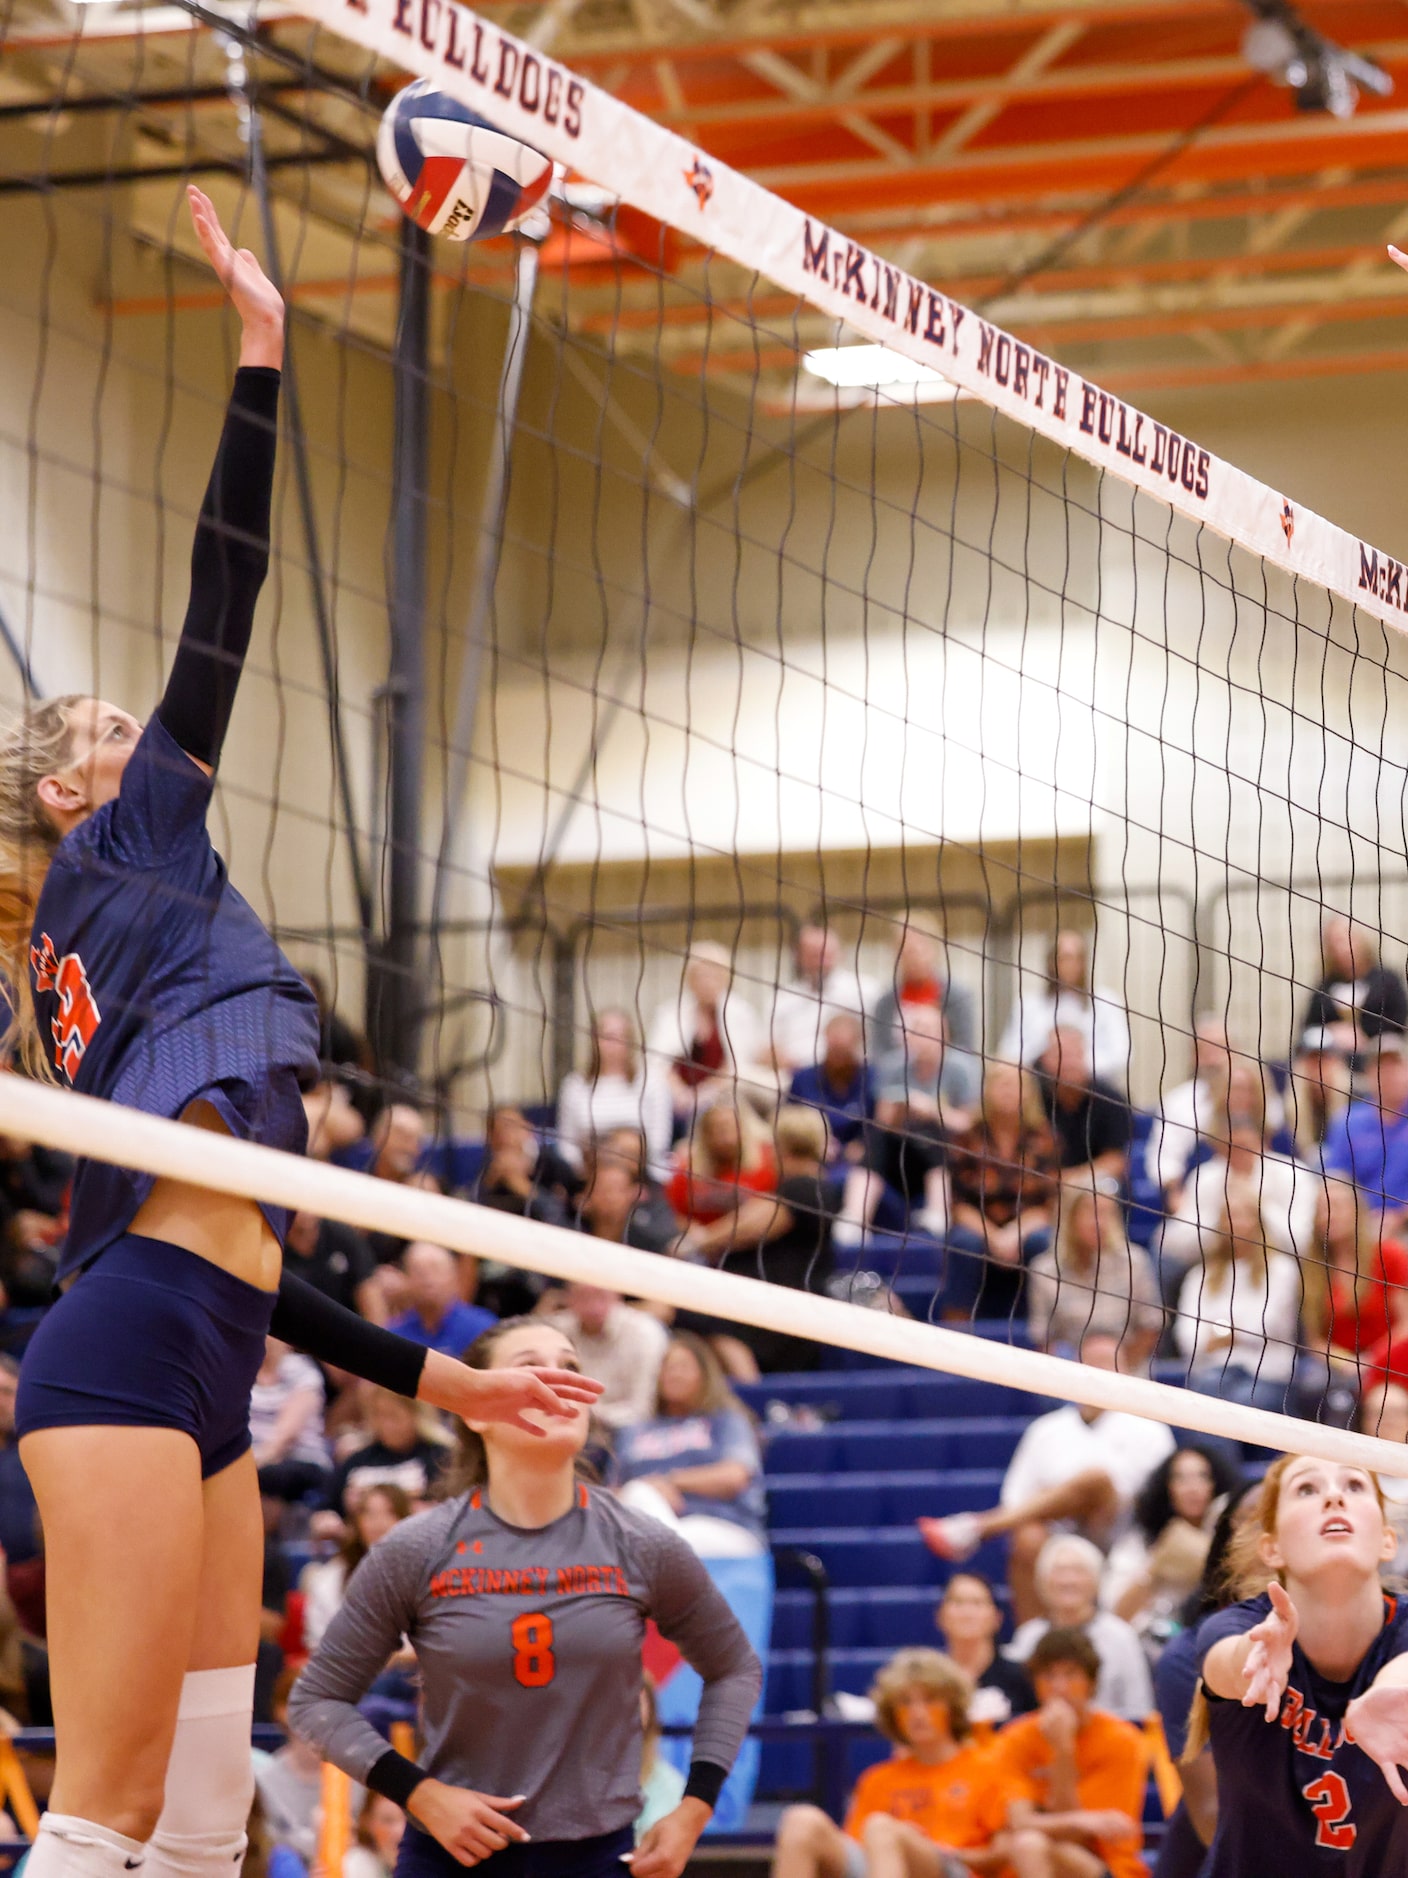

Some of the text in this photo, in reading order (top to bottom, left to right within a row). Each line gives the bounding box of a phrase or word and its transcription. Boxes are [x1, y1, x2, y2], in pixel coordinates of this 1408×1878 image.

[976, 320, 1070, 421] NORTH
[1079, 382, 1212, 501] BULLDOGS
[556, 1565, 631, 1597] NORTH
[511, 1612, 555, 1688] 8
[1302, 1769, 1358, 1851] 2
